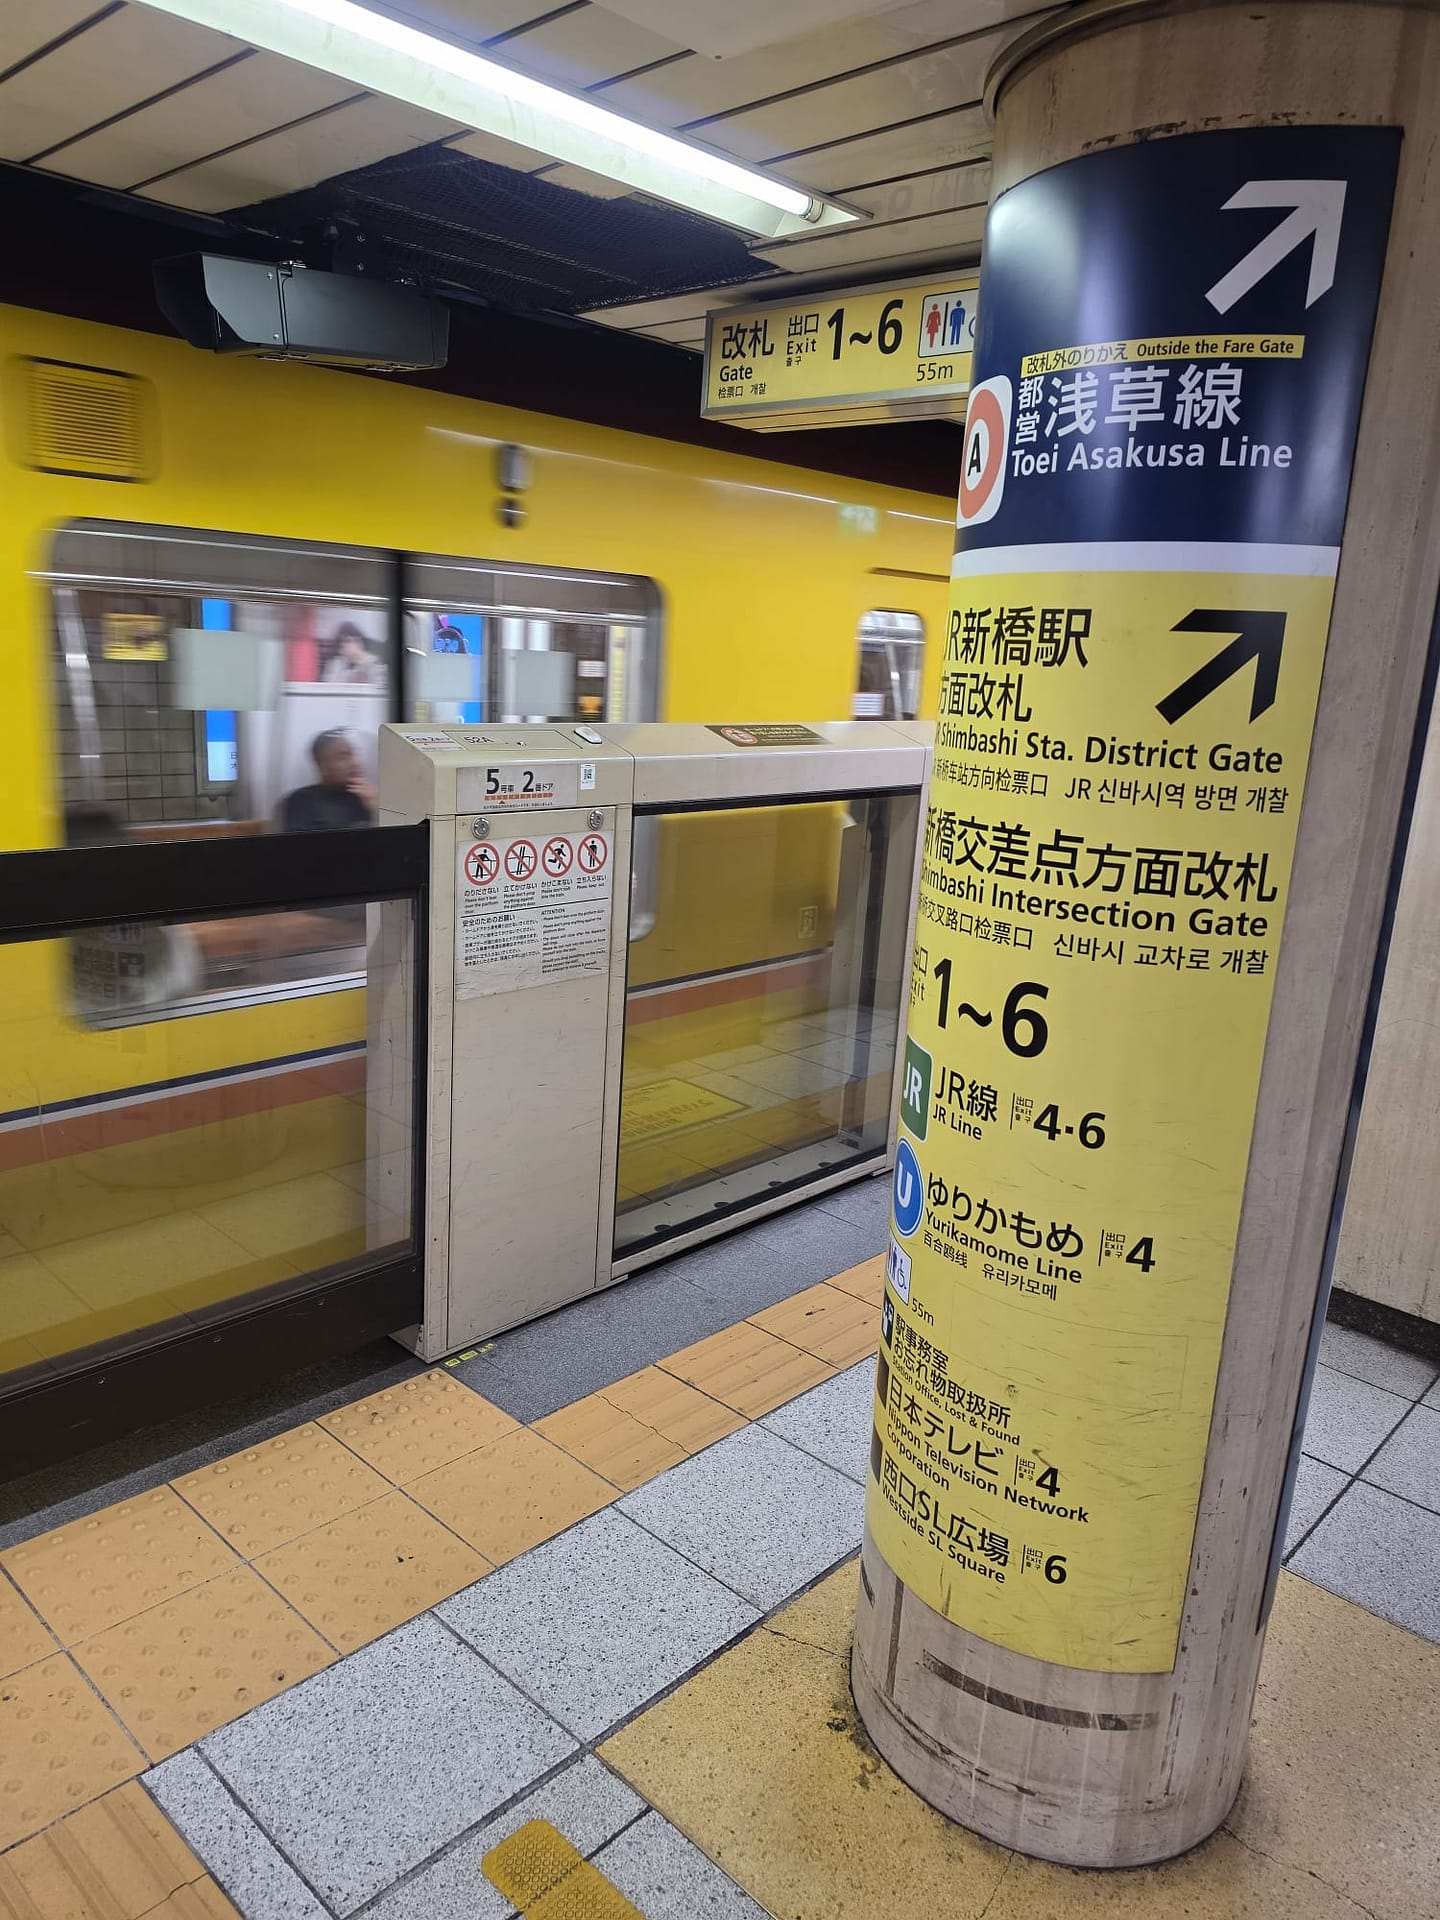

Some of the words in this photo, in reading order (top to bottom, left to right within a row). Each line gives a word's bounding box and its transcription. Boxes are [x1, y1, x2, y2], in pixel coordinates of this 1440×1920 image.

[721, 319, 775, 360] 改札
[787, 313, 820, 338] 出口
[786, 339, 818, 356] Exit
[1027, 343, 1129, 374] 改札外のりかえ
[1136, 341, 1190, 358] Outside
[1195, 340, 1218, 355] the
[1223, 339, 1255, 354] Fare
[1259, 339, 1295, 354] Gate
[719, 364, 753, 382] Gate
[750, 382, 767, 396] 개찰
[916, 362, 954, 382] 55m
[718, 385, 744, 399] 检票口
[1015, 375, 1044, 446] 都営
[1044, 362, 1244, 439] 浅草線
[967, 432, 982, 477] A
[1012, 443, 1060, 477] Toei
[1066, 436, 1205, 473] Asakusa
[1219, 435, 1294, 469] Line
[941, 722, 1018, 757] Shimbashi
[1025, 731, 1074, 762] Sta.
[1085, 735, 1199, 770] District
[1208, 743, 1283, 774] Gate
[1065, 777, 1091, 800] JR
[1098, 778, 1187, 809] 신바시역
[1195, 784, 1238, 812] 방면
[1245, 785, 1290, 814] 개찰
[990, 882, 1177, 933] Intersection
[1188, 908, 1268, 938] Gate
[1053, 933, 1126, 965] 신바시
[1134, 943, 1211, 972] 교차로
[1220, 950, 1269, 976] 개찰
[903, 1062, 924, 1115] JR
[935, 1066, 999, 1124] JR線
[1015, 1096, 1034, 1109] 出口
[932, 1104, 946, 1123] JR
[950, 1111, 983, 1140] Line
[1015, 1105, 1033, 1116] Exit
[897, 1161, 912, 1208] U
[927, 1172, 1084, 1258] ゆりかもめ
[923, 1229, 968, 1269] 百合鸥线
[925, 1207, 1029, 1269] Yurikamome
[1036, 1257, 1082, 1283] Line
[1105, 1232, 1125, 1244] 出口
[1105, 1242, 1124, 1251] Exit
[1126, 1236, 1156, 1273] 4
[981, 1263, 1058, 1301] 유리카모메
[912, 1297, 934, 1327] 55m
[895, 1313, 949, 1375] 駅事務室
[893, 1338, 1011, 1429] お忘れ物取扱所
[890, 1374, 1005, 1476] 日本テレビ
[915, 1380, 942, 1409] Office,
[945, 1401, 966, 1423] Lost
[969, 1415, 978, 1429] &
[981, 1421, 1020, 1446] Found
[886, 1423, 950, 1491] Corporation
[887, 1404, 921, 1449] Nippon
[924, 1438, 998, 1496] Television
[1004, 1485, 1089, 1523] Network
[1018, 1457, 1036, 1470] 出口
[1018, 1465, 1035, 1476] Exit
[1035, 1466, 1061, 1498] 4
[884, 1451, 1010, 1567] 西口SL広場
[882, 1480, 925, 1537] Westside
[928, 1531, 944, 1552] SL
[948, 1544, 1006, 1584] Square
[1026, 1547, 1043, 1559] 出口
[1026, 1555, 1043, 1565] Exit
[1044, 1554, 1067, 1585] 6
